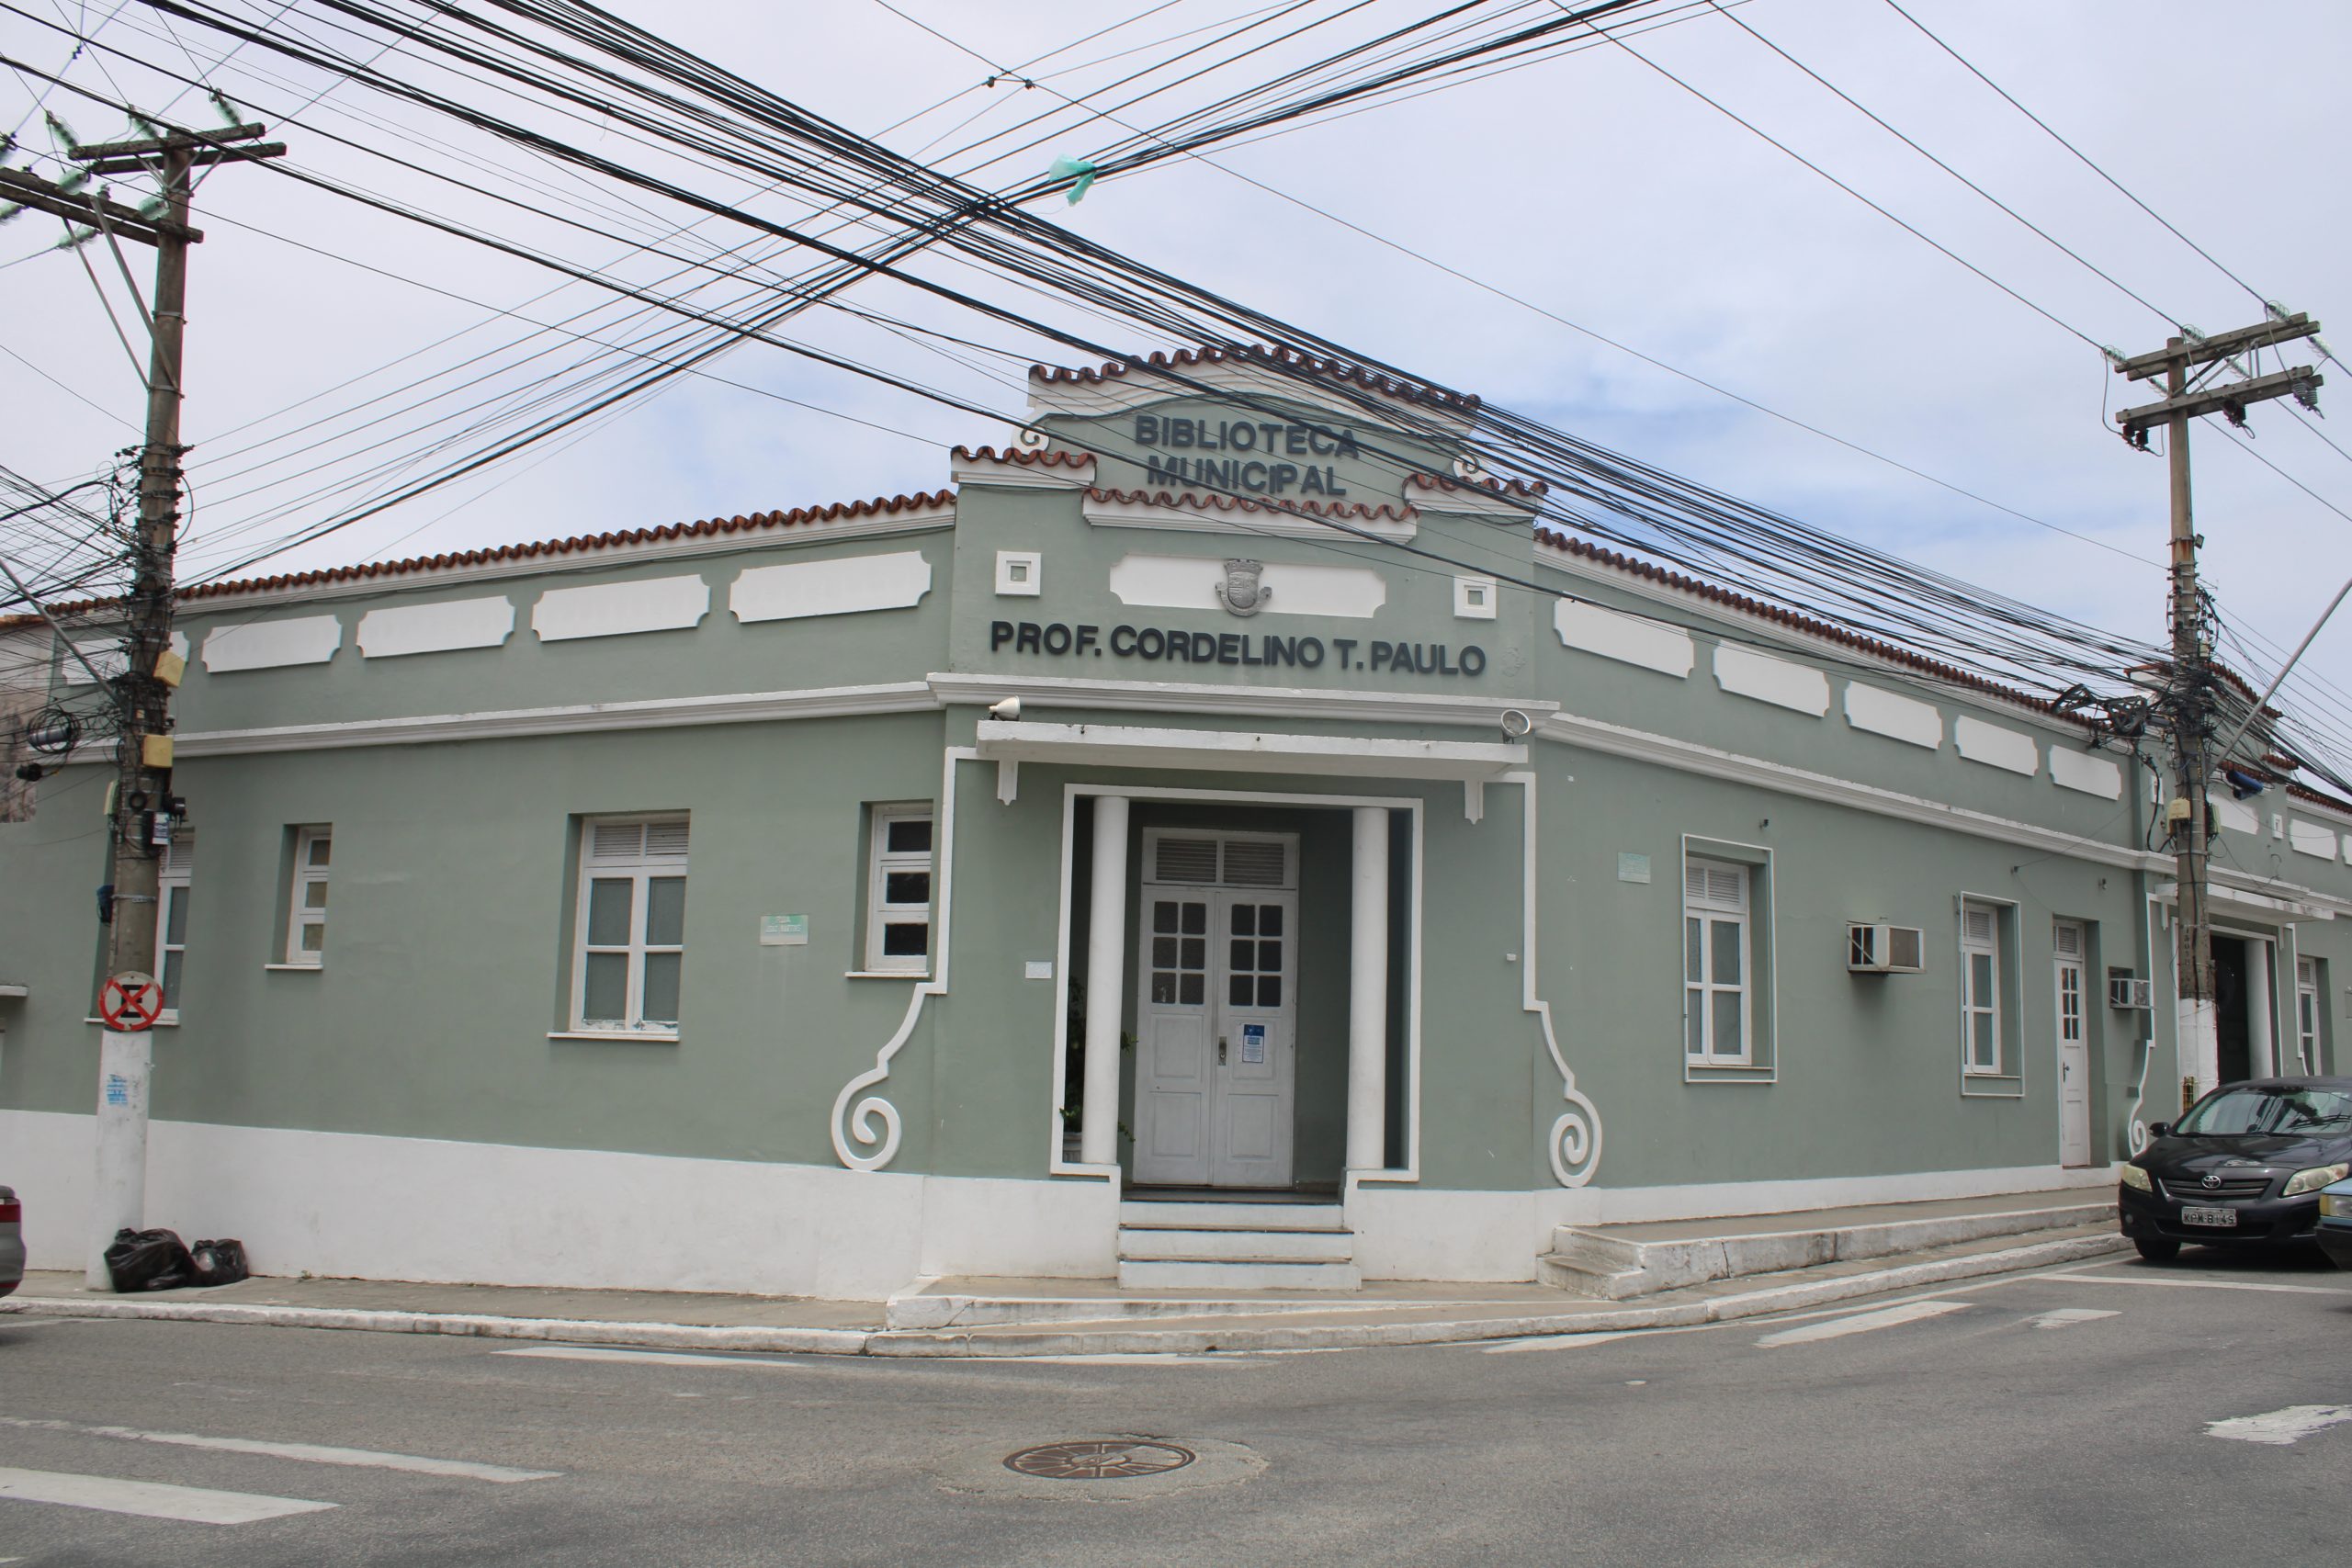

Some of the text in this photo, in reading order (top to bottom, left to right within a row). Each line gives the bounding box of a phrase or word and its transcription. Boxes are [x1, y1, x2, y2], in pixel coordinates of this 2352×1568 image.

[1136, 415, 1360, 459] BIBLIOTECA
[1148, 455, 1347, 495] MUNICIPAL
[991, 620, 1487, 677] PROF. CORDELINO T. PAULO
[120, 984, 144, 1018] E
